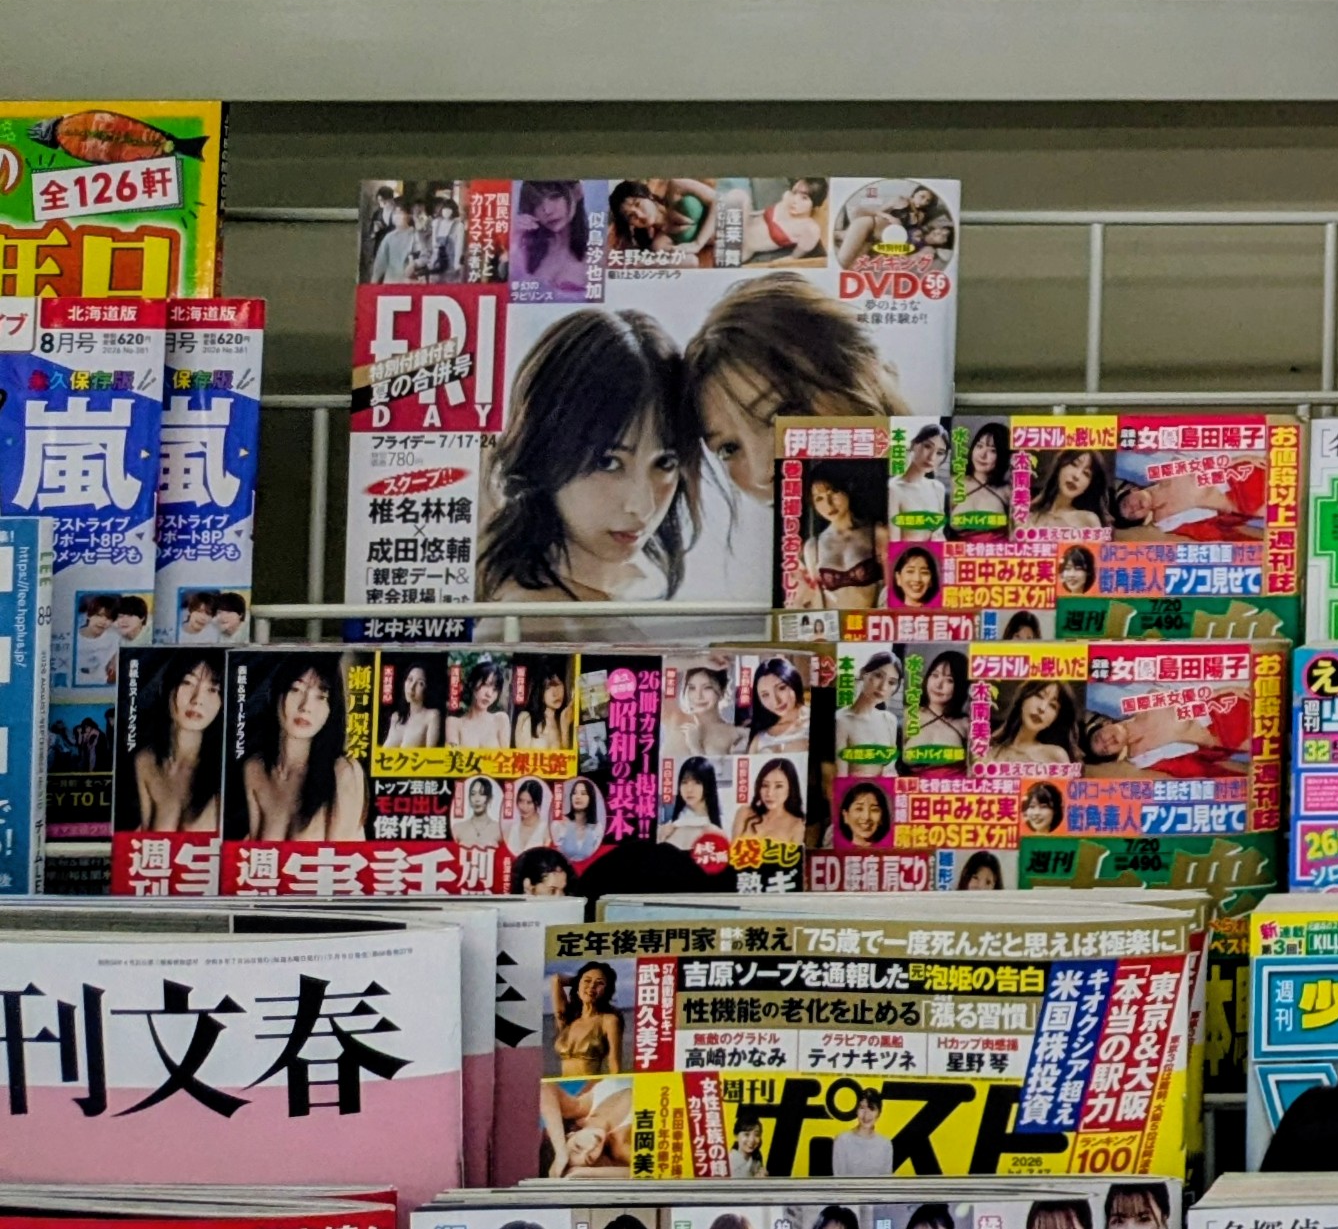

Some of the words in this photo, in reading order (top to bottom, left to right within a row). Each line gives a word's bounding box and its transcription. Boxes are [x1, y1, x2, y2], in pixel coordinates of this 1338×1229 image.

[39, 167, 173, 212] 全126軒
[495, 192, 510, 233] 国民的
[467, 193, 484, 283] カリスマ学者が
[482, 193, 496, 277] アーティストと
[585, 212, 605, 300] 似鳥沙也加
[608, 249, 686, 266] 矢野ななか
[856, 254, 932, 271] メイキング
[839, 271, 920, 300] DVD
[68, 305, 137, 322] 北海道版
[170, 305, 236, 322] 北海道版
[864, 300, 921, 311] 夢のような
[40, 333, 97, 354] 8月号
[370, 354, 472, 405] 夏の合併号
[14, 397, 142, 511] 嵐
[372, 436, 436, 450] フライデー
[1269, 426, 1298, 527] お値段以上
[368, 497, 473, 525] 椎名林檎
[367, 537, 471, 564] 成田悠輔
[1267, 531, 1297, 595] 週刊誌
[957, 559, 1056, 586] 田中みな実
[364, 617, 465, 639] 北中米W杯
[1253, 655, 1282, 760] お値段以上
[1304, 700, 1320, 732] 週刊
[1304, 739, 1330, 761] 32
[606, 702, 637, 841] 昭和の裏本
[374, 779, 451, 795] トップ芸能人
[1253, 762, 1281, 830] 週刊誌
[375, 796, 448, 814] モロ出し
[910, 795, 1017, 823] 田中みな実
[374, 815, 447, 839] 傑作選
[732, 839, 801, 869] 袋とじ
[557, 927, 717, 957] 定年後専門家
[635, 963, 660, 1069] 武田久美子
[1275, 979, 1294, 1032] 週刊
[808, 1048, 917, 1070] ティナキツネ
[1020, 969, 1083, 1126] 米国株投資
[722, 1077, 776, 1104] 週刊
[1081, 1133, 1137, 1148] ランキング
[1012, 1156, 1043, 1168] 2026
[1078, 1146, 1132, 1174] 100
